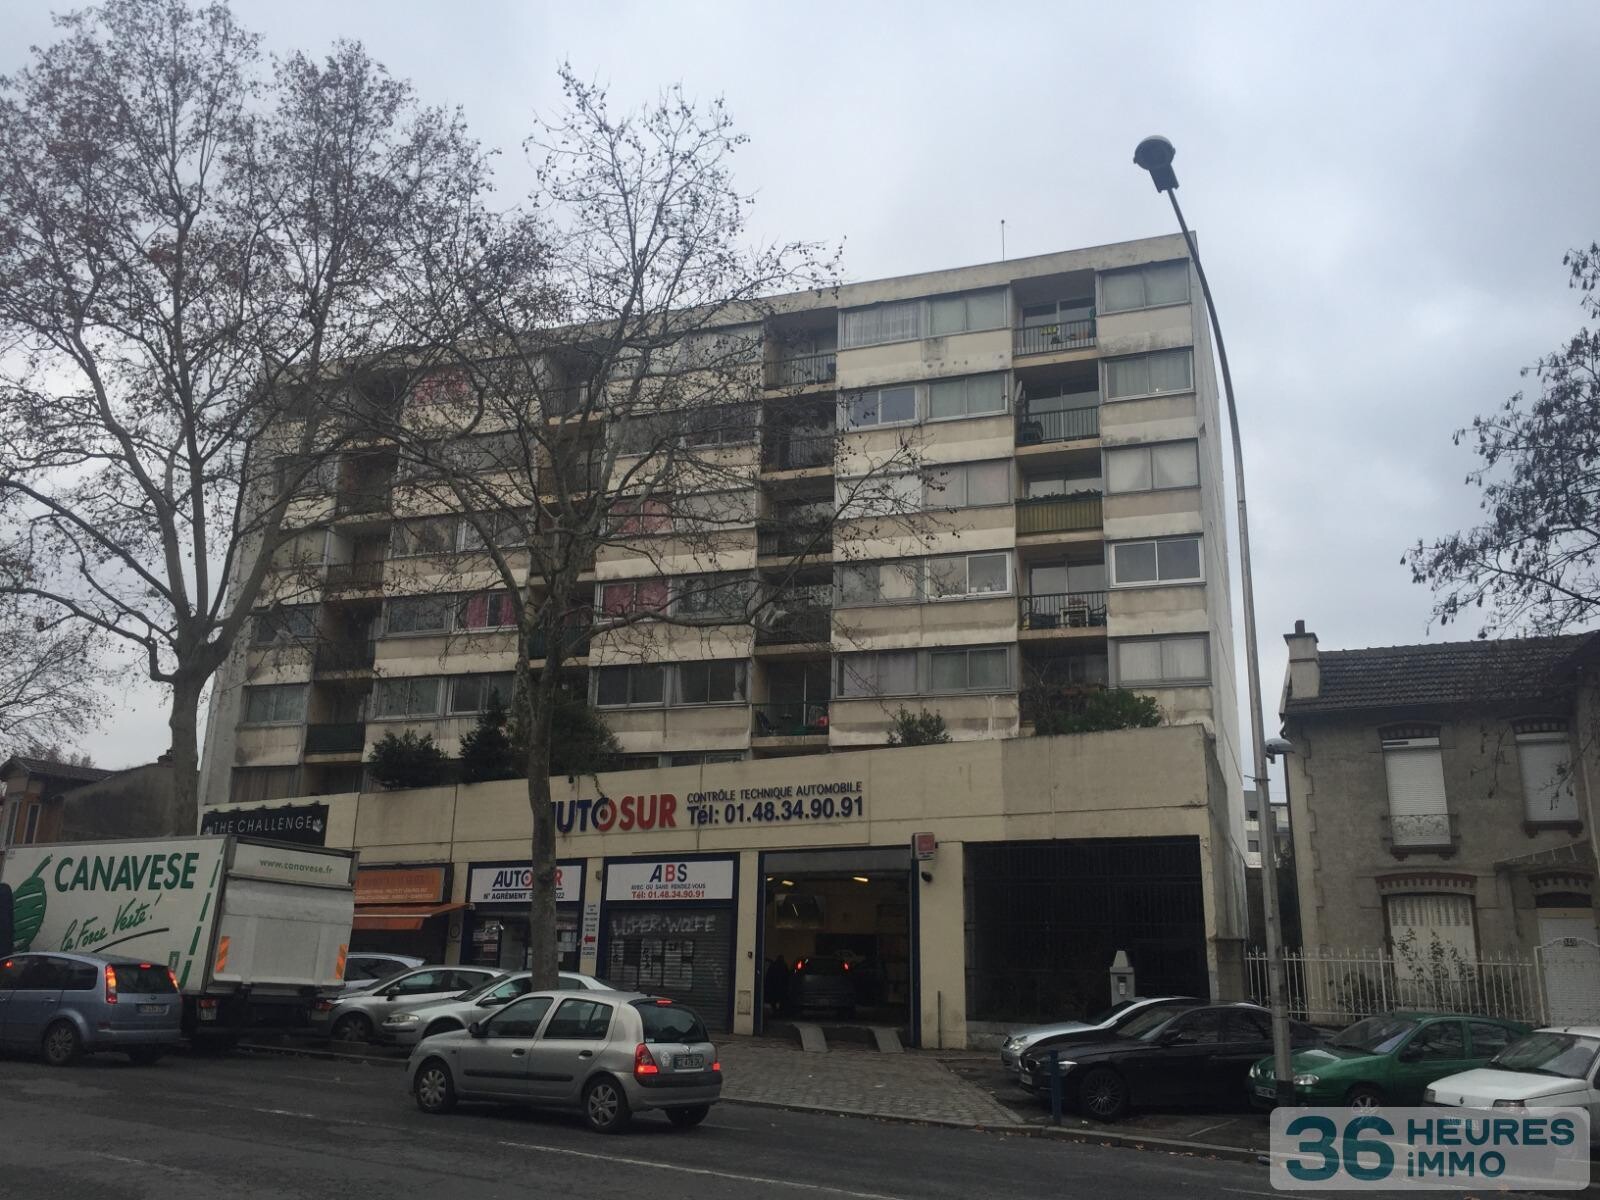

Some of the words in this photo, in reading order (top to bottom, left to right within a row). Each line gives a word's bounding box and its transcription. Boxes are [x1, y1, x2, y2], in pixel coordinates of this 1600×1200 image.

[687, 789, 736, 803] CONTRÔLE
[740, 786, 793, 800] TECHNIQUE
[796, 781, 863, 796] AUTOMOBILE
[687, 804, 719, 824] Tél:
[724, 796, 863, 824] 01.48.34.90.91
[214, 820, 234, 833] THE
[238, 816, 313, 833] CHALLENGE
[55, 853, 199, 892] CANAVESE
[260, 859, 333, 874] www.canavese.fr
[649, 863, 687, 882] ABS
[492, 868, 563, 888] AUTOR
[648, 890, 705, 899] 01.48.34.90.91
[75, 916, 108, 950] Force
